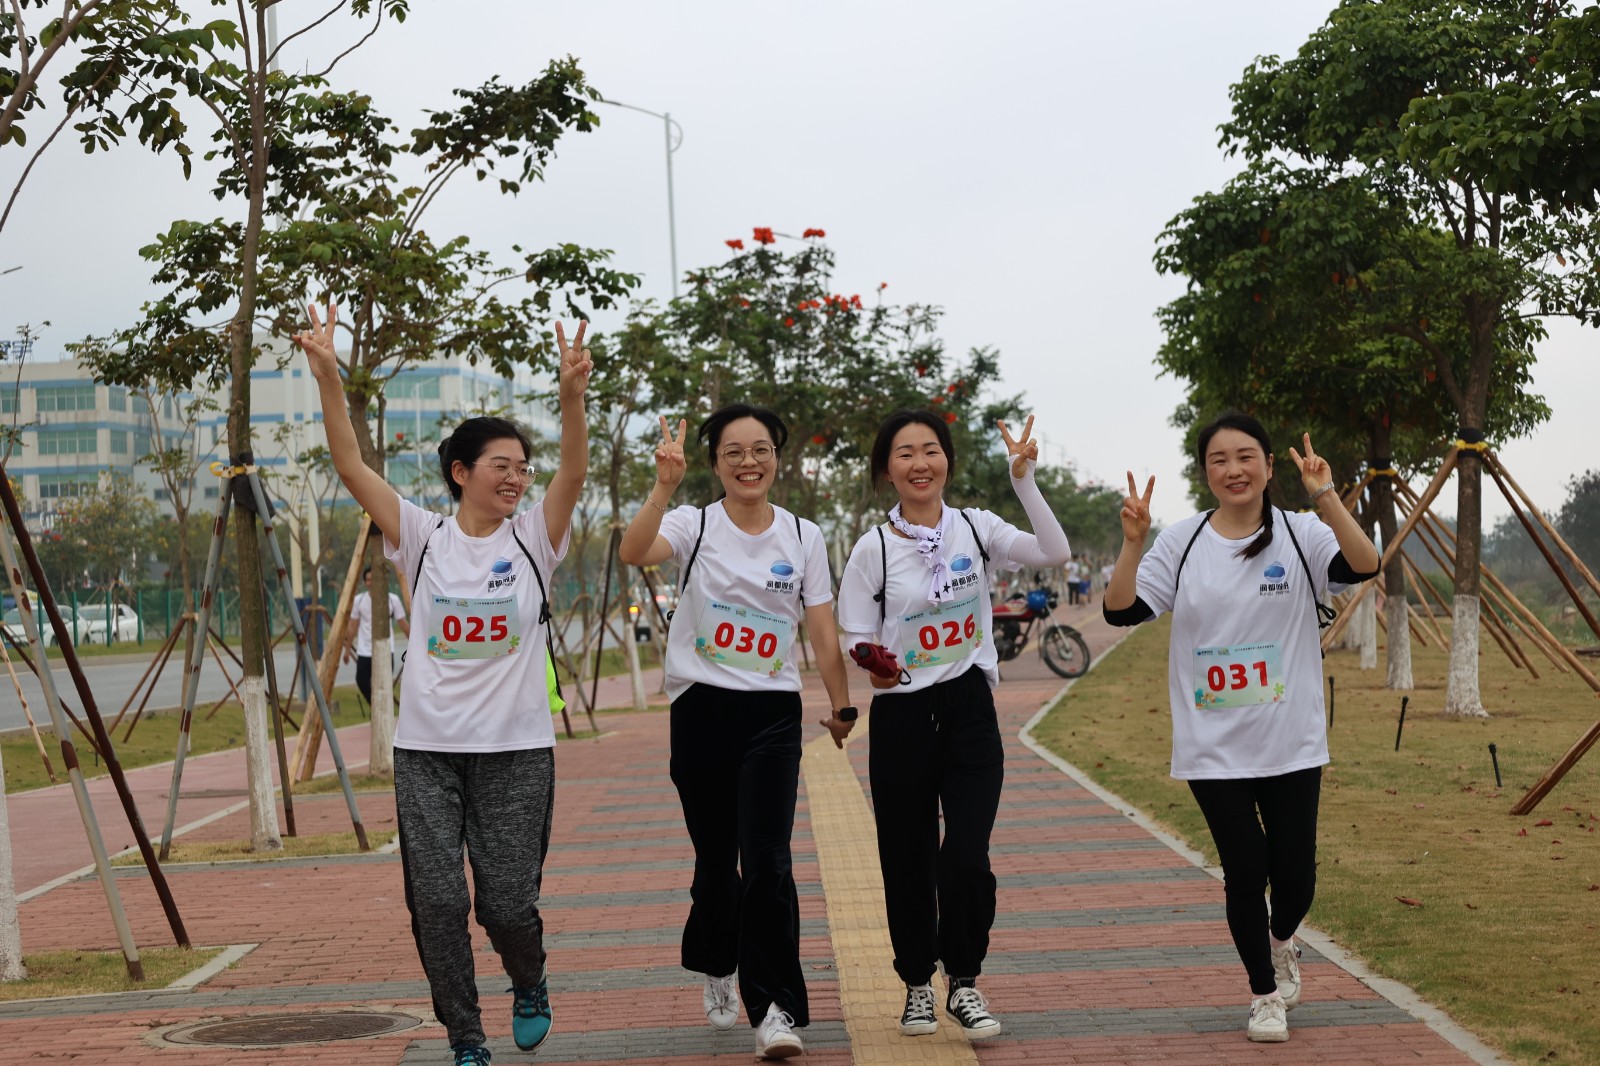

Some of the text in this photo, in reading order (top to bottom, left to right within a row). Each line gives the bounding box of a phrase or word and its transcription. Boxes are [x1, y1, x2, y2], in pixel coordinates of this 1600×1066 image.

[443, 615, 508, 642] 025
[714, 622, 778, 658] 030
[919, 613, 977, 651] 026
[1207, 661, 1268, 692] 031
